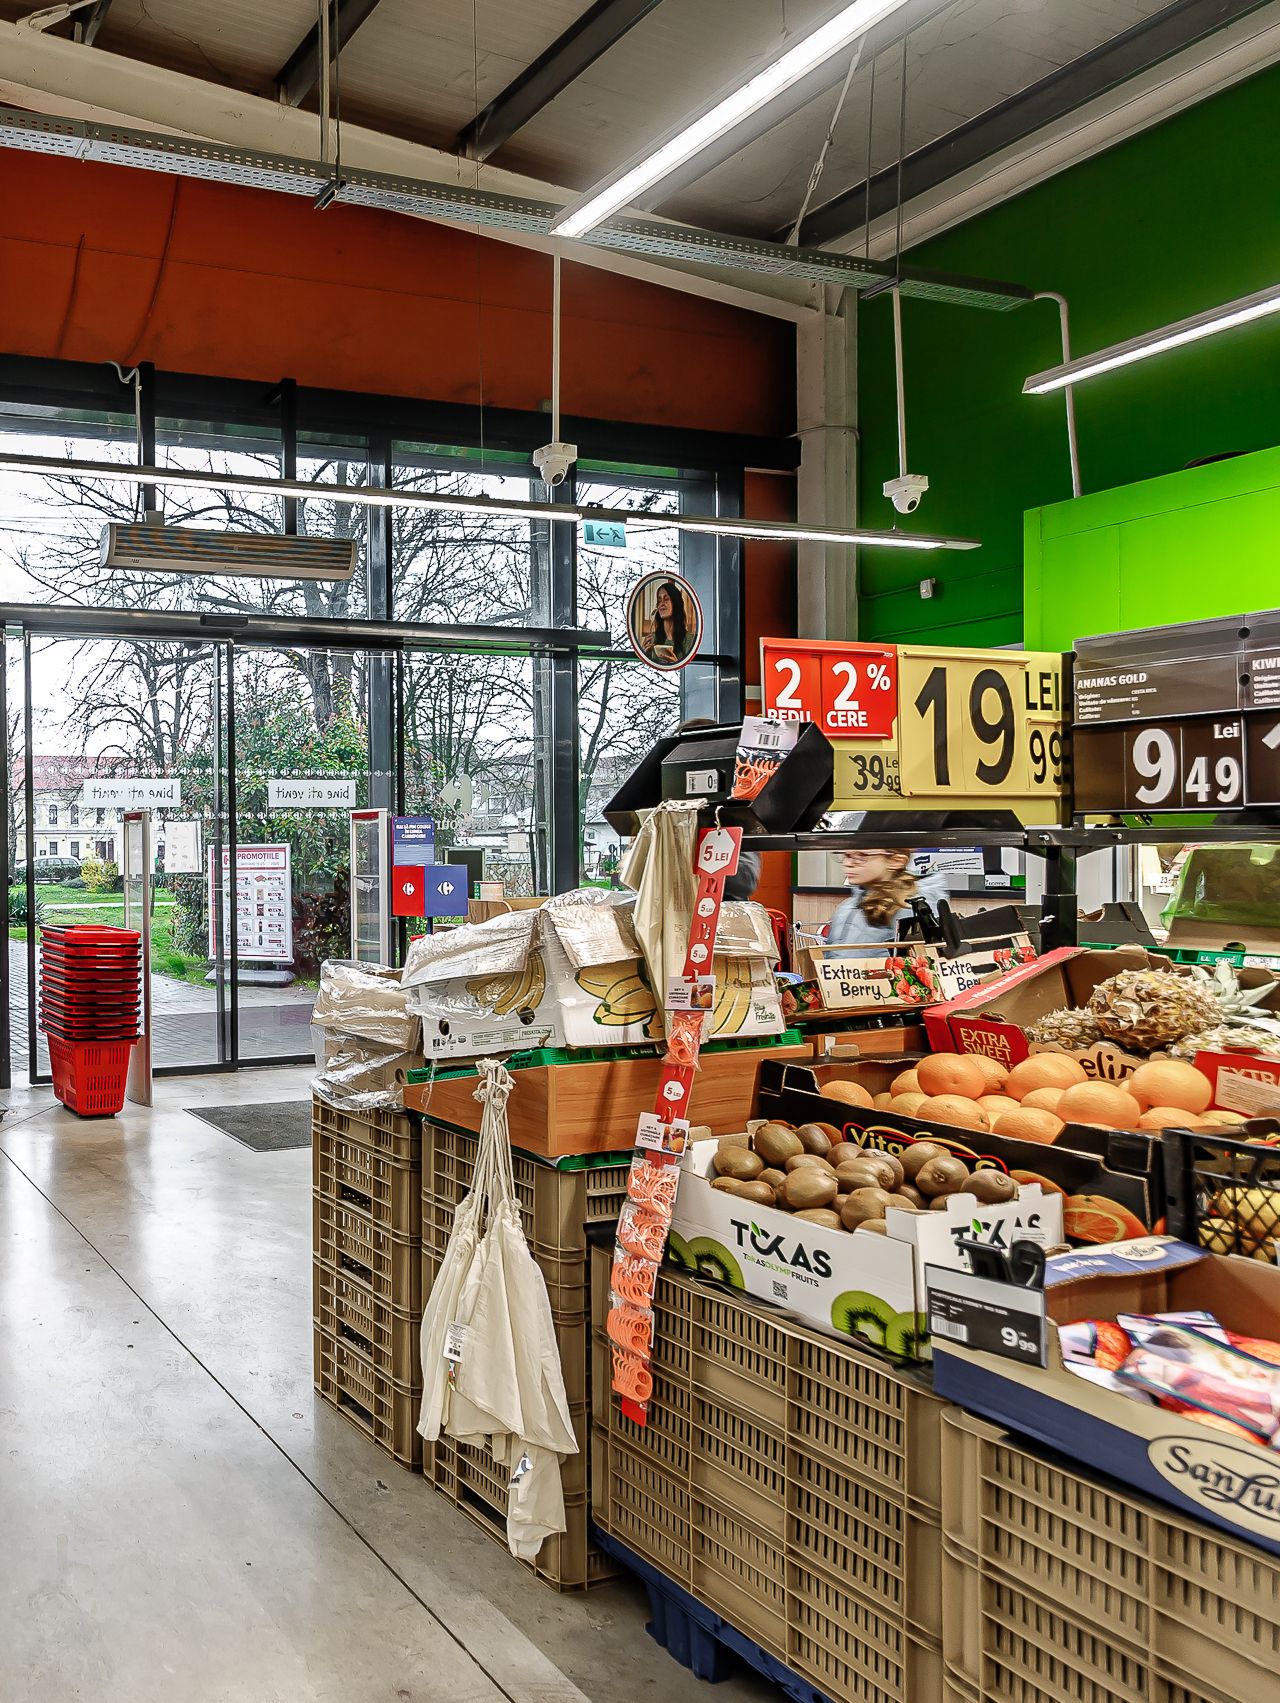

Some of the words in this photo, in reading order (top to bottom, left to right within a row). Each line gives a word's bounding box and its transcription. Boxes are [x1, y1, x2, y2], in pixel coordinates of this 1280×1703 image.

[1077, 675, 1118, 690] ANANAS
[1119, 672, 1147, 685] GOLD
[826, 710, 869, 728] CERE
[914, 666, 1016, 787] 19
[1025, 671, 1059, 711] LEI
[1213, 723, 1240, 739] Lei
[886, 757, 899, 768] Le
[1132, 728, 1176, 804] 9
[1184, 756, 1241, 803] 49
[703, 845, 713, 861] 5
[715, 852, 729, 862] LEI
[823, 964, 862, 980] Extra
[940, 961, 972, 977] Extra
[840, 982, 880, 1000] Berry
[960, 1027, 1011, 1049] EXTRA
[963, 1042, 1011, 1062] SWEET
[950, 1213, 1041, 1256] TKS
[1001, 1327, 1019, 1347] 9
[1018, 1339, 1038, 1354] 99
